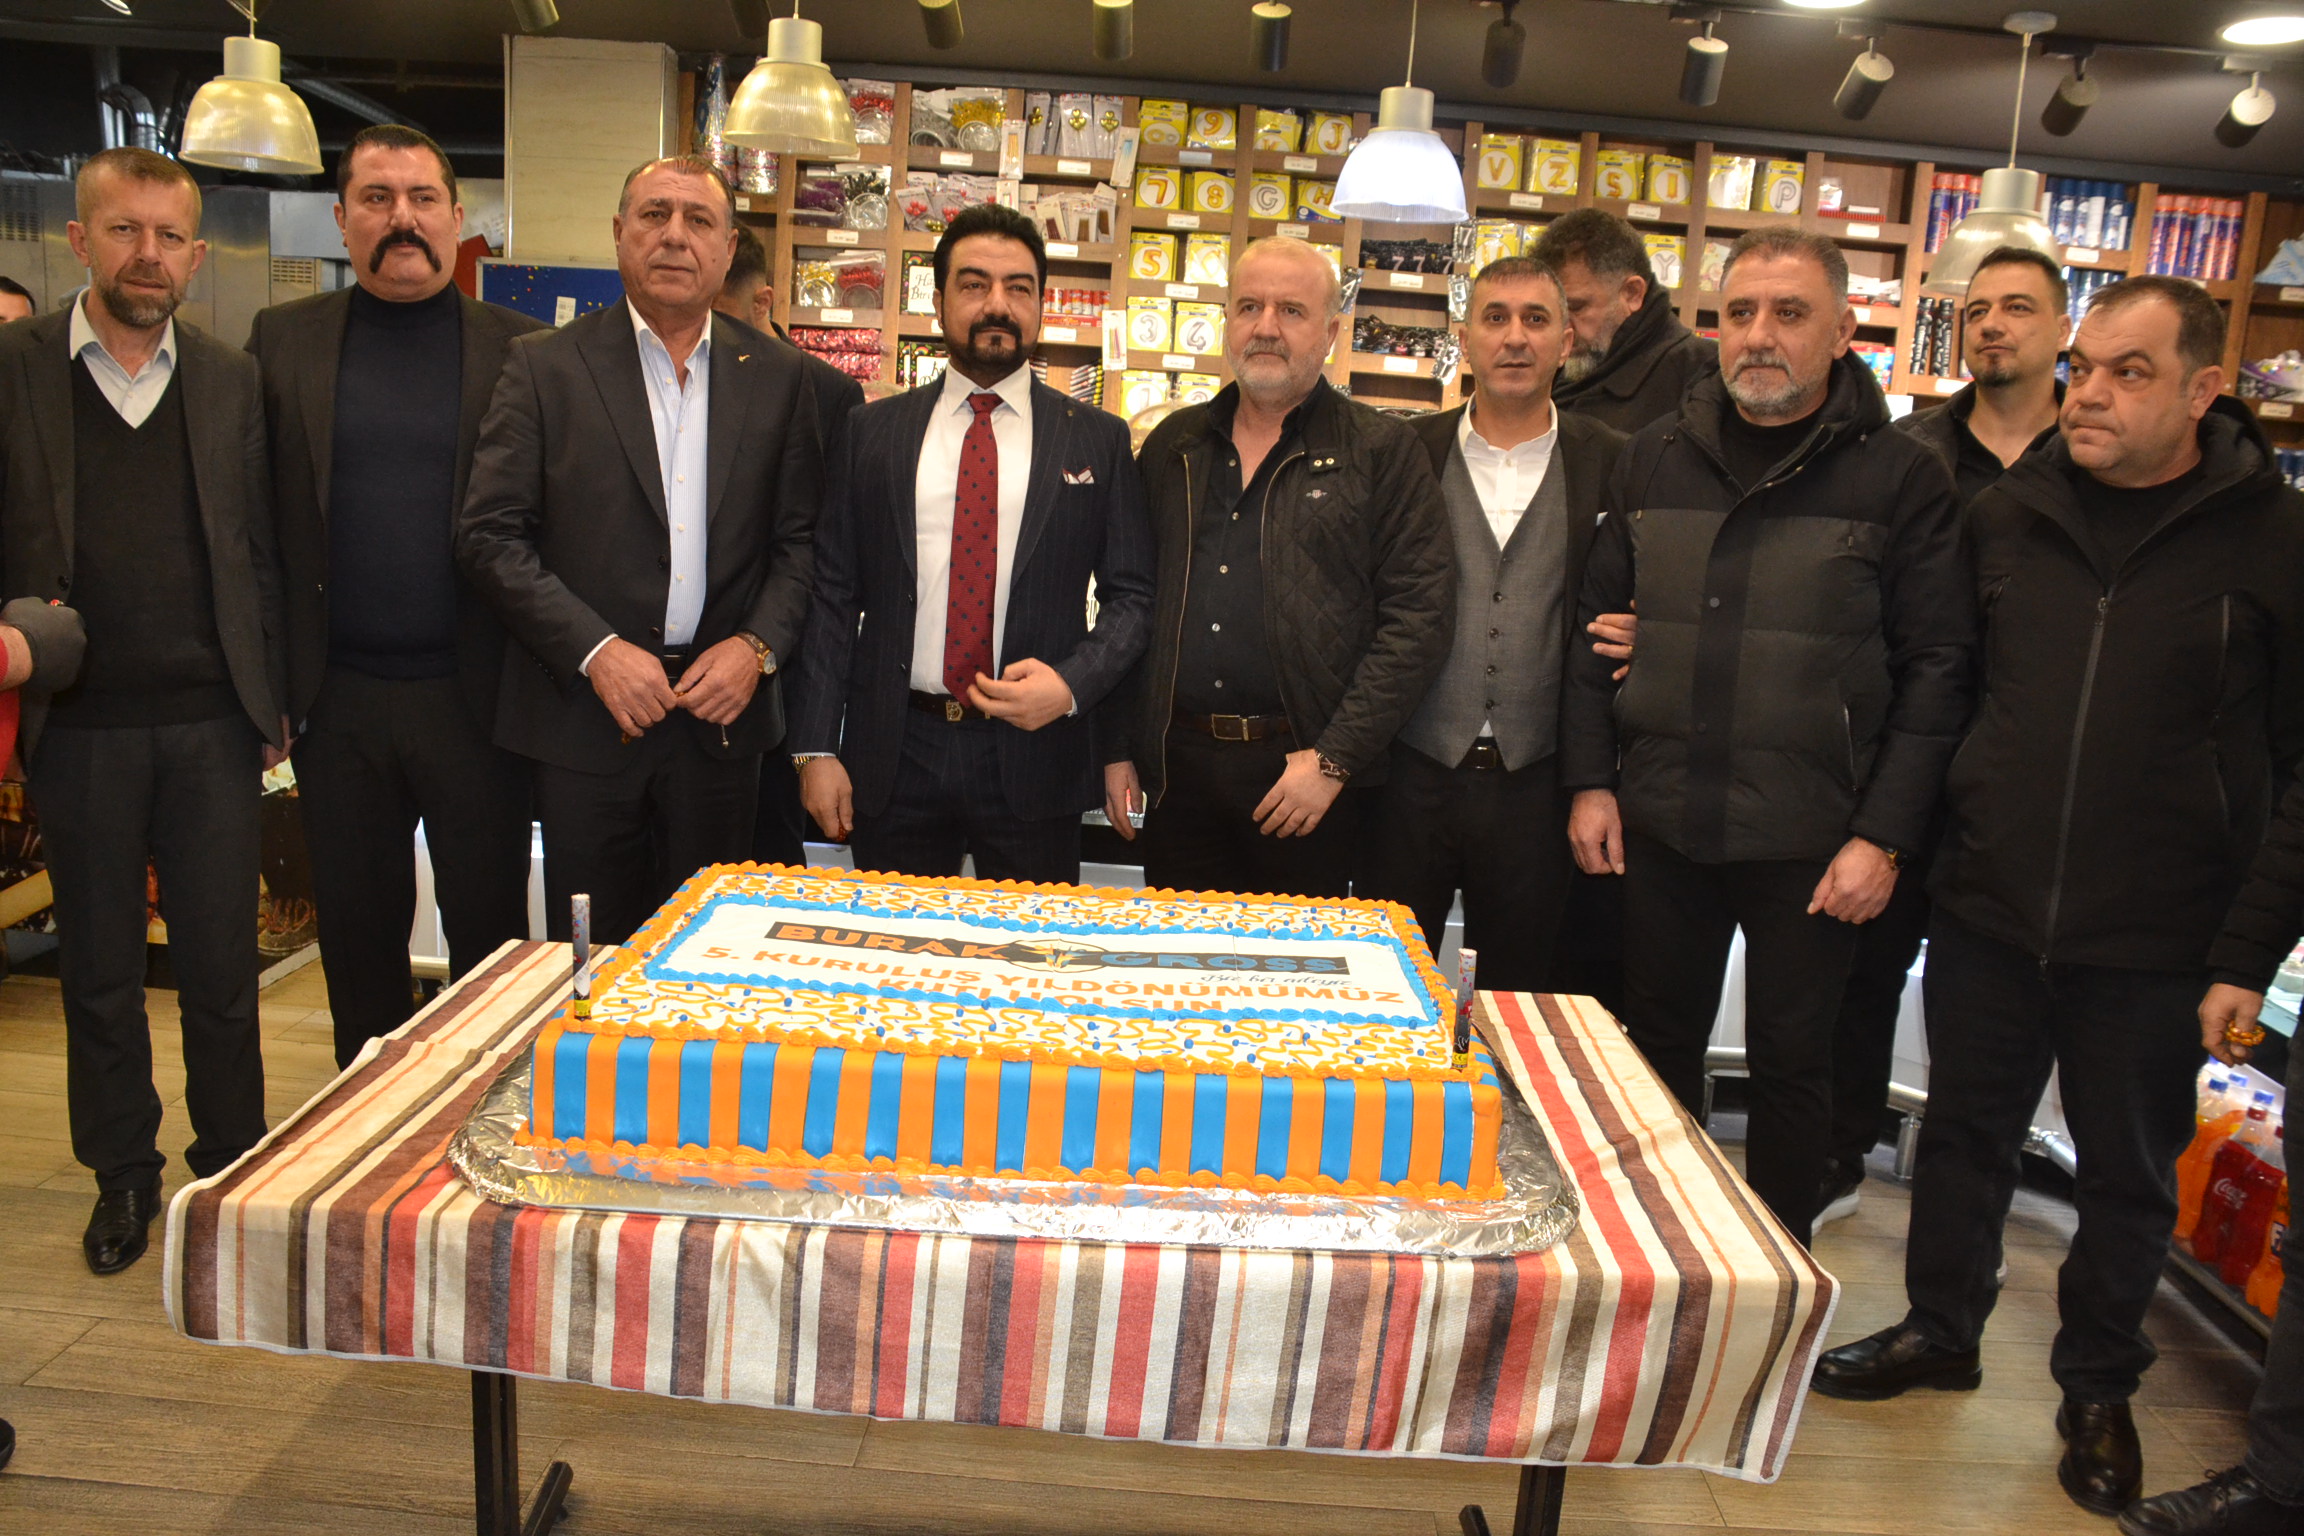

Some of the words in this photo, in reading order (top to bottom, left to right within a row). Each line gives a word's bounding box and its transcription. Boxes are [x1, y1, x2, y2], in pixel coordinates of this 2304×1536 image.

[1204, 112, 1224, 136] 9
[1324, 122, 1344, 150] J
[1487, 156, 1507, 182] V
[1548, 160, 1569, 188] Z
[1147, 177, 1168, 204] 7
[1207, 183, 1225, 209] 8
[1256, 186, 1278, 210] G
[1312, 186, 1335, 206] H
[1606, 171, 1623, 197] S
[1775, 180, 1797, 209] P
[1139, 249, 1162, 277] 5
[1656, 253, 1676, 281] Y
[1139, 314, 1158, 343] 3
[775, 924, 1010, 960] BURAK
[1100, 953, 1338, 972] GROSS
[701, 946, 740, 960] 5.
[753, 950, 981, 984] KURULUŞ
[994, 974, 1405, 1003] YILDÖNÜMÜMÜZ
